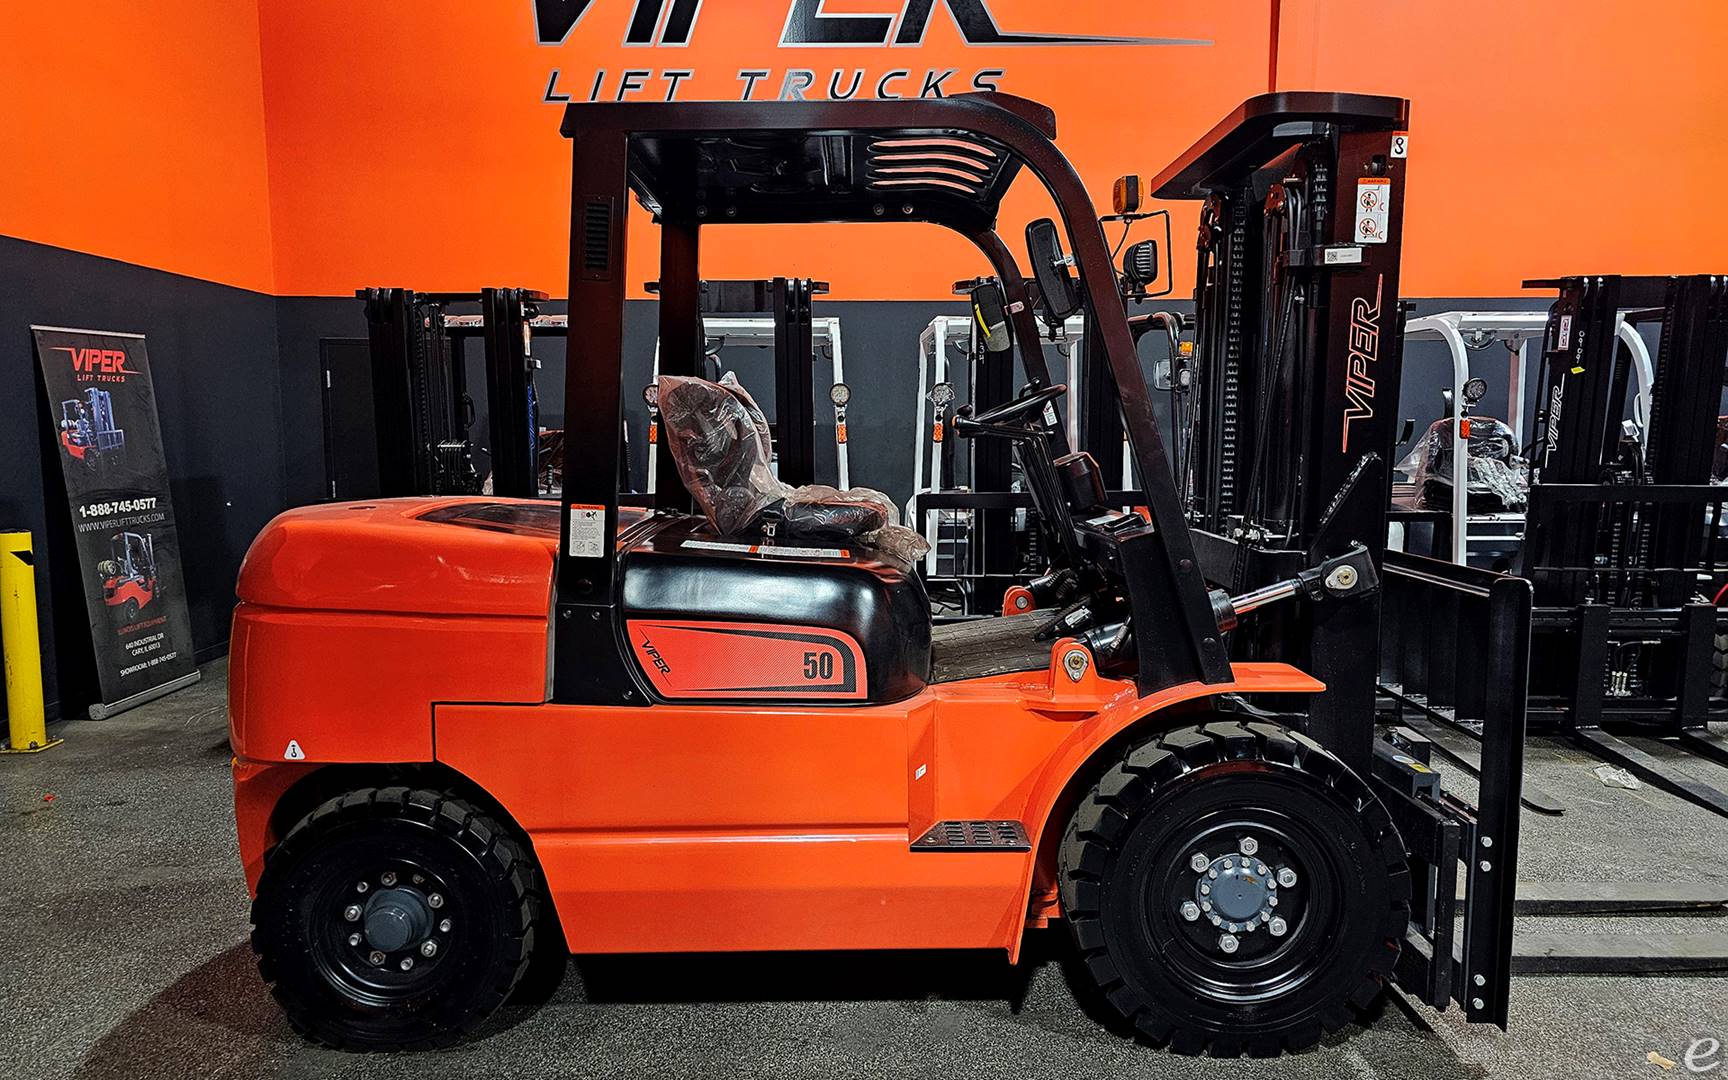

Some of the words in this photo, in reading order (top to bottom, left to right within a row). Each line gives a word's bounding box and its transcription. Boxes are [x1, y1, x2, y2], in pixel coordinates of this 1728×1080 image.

[543, 68, 696, 103] LIFT
[736, 68, 1006, 102] TRUCKS
[77, 374, 94, 382] LIFT
[97, 375, 126, 383] TRUCKS
[79, 497, 157, 518] 1-888-745-0577
[78, 513, 165, 533] WWW.VIPERLIFTTRUCKS.COM
[803, 651, 833, 680] 50
